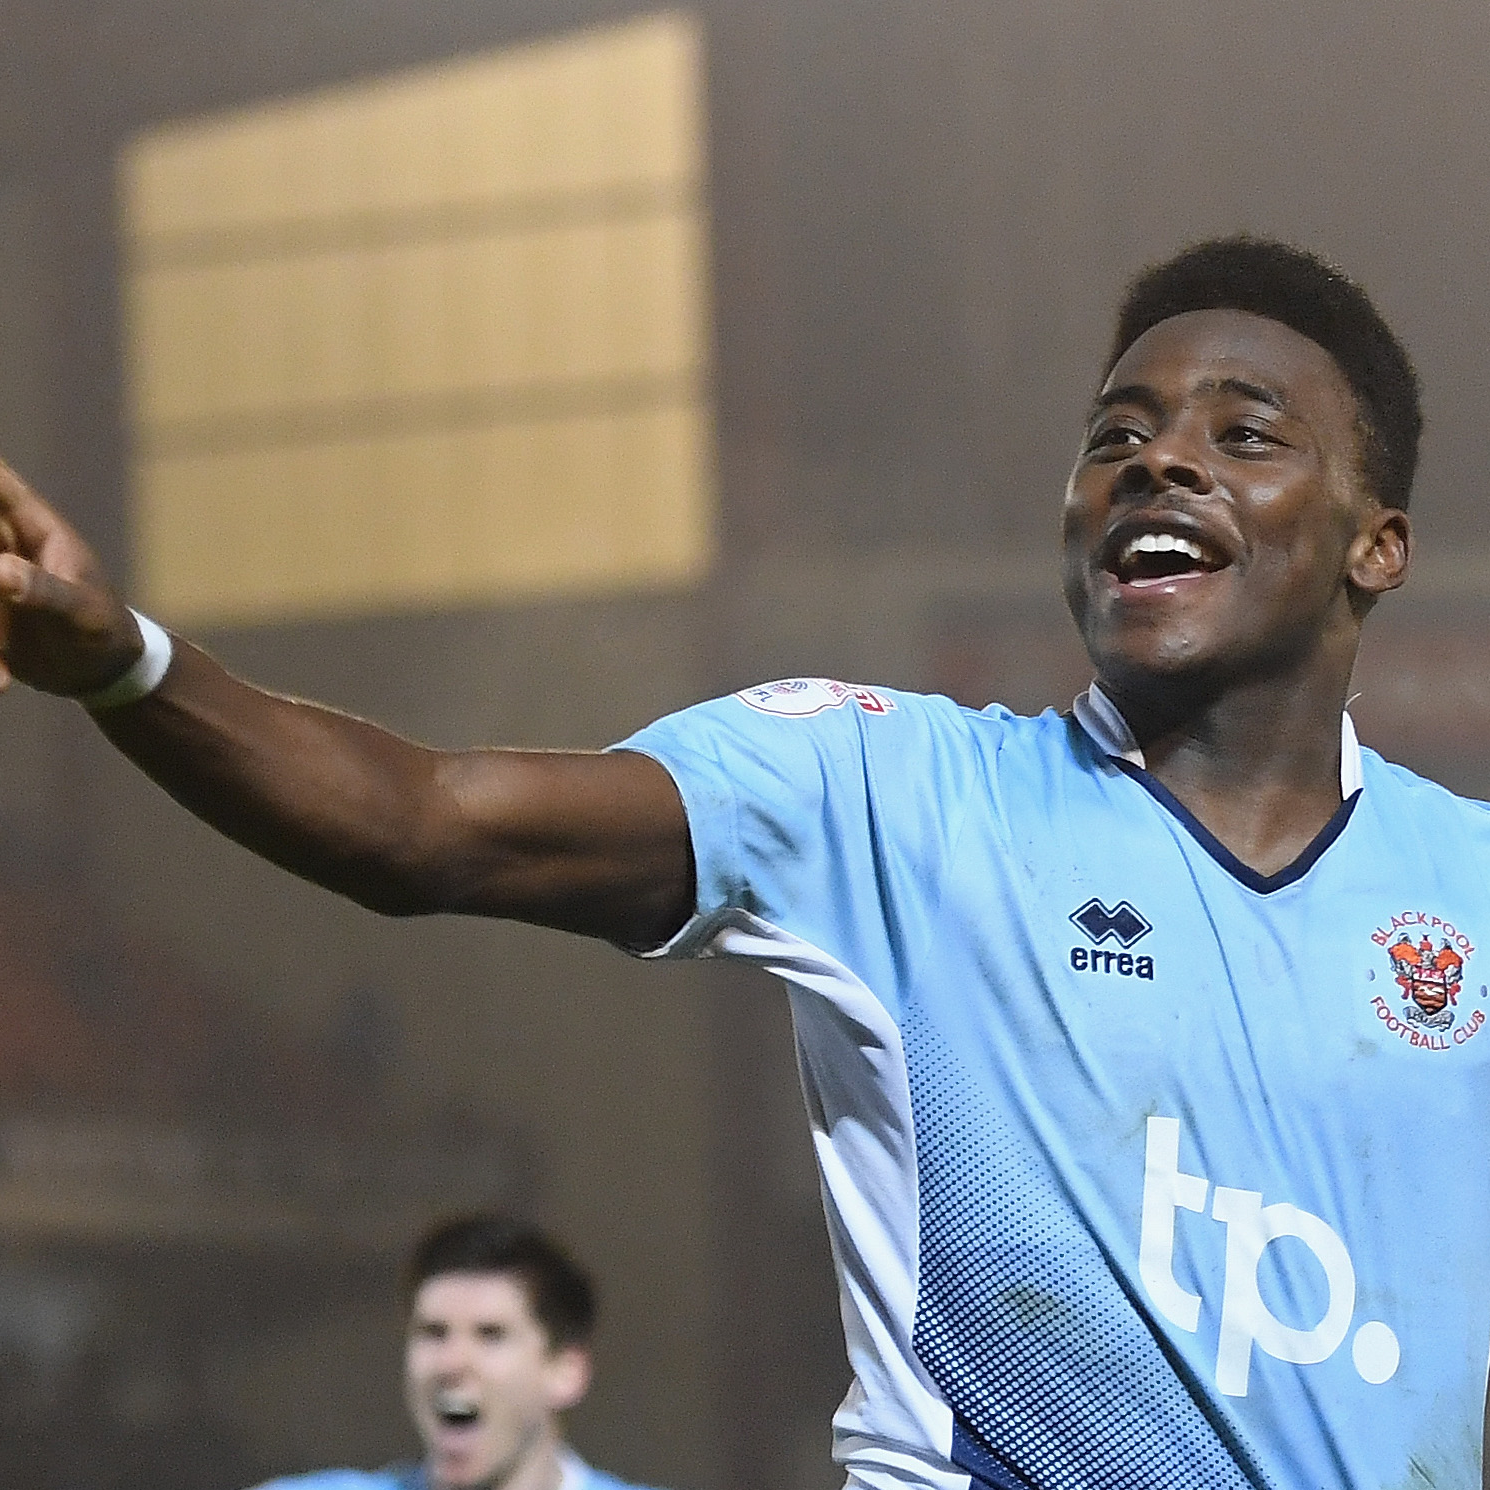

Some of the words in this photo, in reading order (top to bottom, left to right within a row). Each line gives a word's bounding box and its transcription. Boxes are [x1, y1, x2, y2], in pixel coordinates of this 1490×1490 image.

[1370, 911, 1476, 961] BLACKPOOL
[1070, 946, 1155, 982] errea
[1369, 996, 1451, 1050] FOOTBALL
[1452, 1009, 1487, 1045] CLUB
